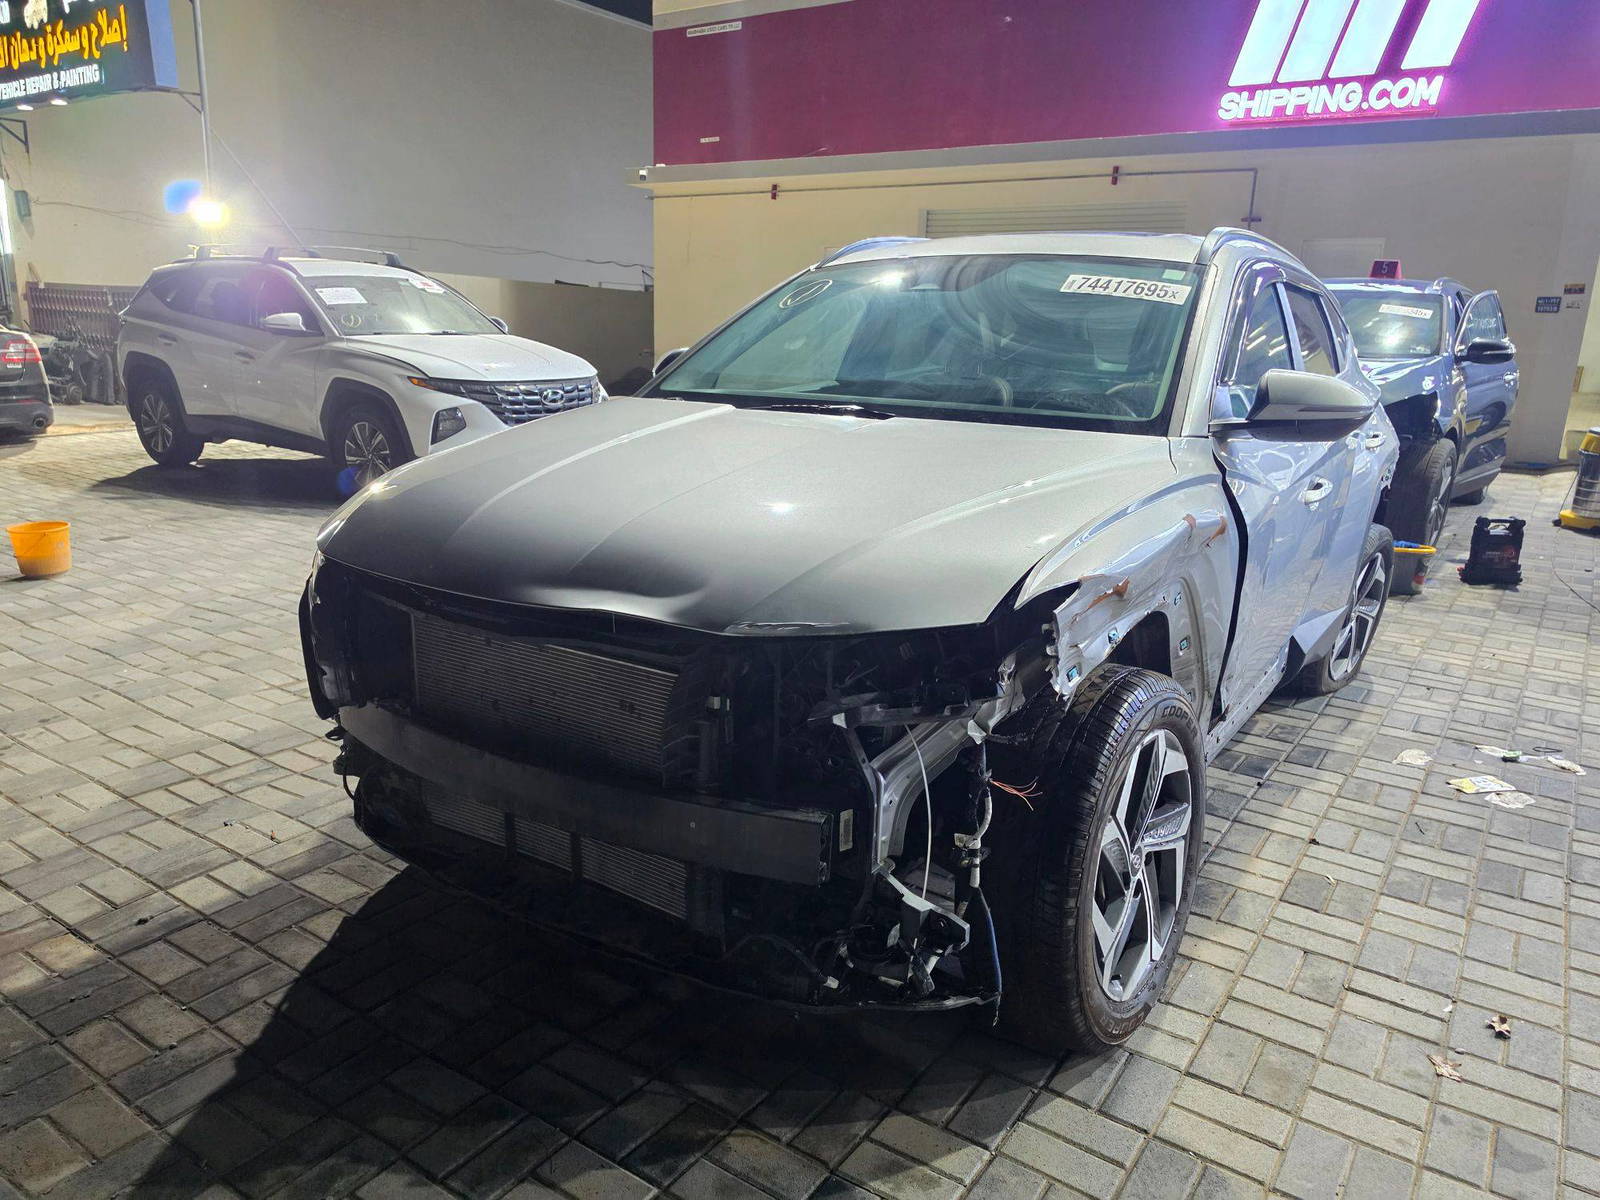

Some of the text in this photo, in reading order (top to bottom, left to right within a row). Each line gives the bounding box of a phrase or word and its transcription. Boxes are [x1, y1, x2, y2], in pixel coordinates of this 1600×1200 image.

[0, 63, 100, 99] EHICLE REPAIR & PAINTING
[1218, 75, 1444, 120] SHIPPING.COM
[1381, 262, 1389, 274] 5
[1161, 705, 1198, 740] COOPER
